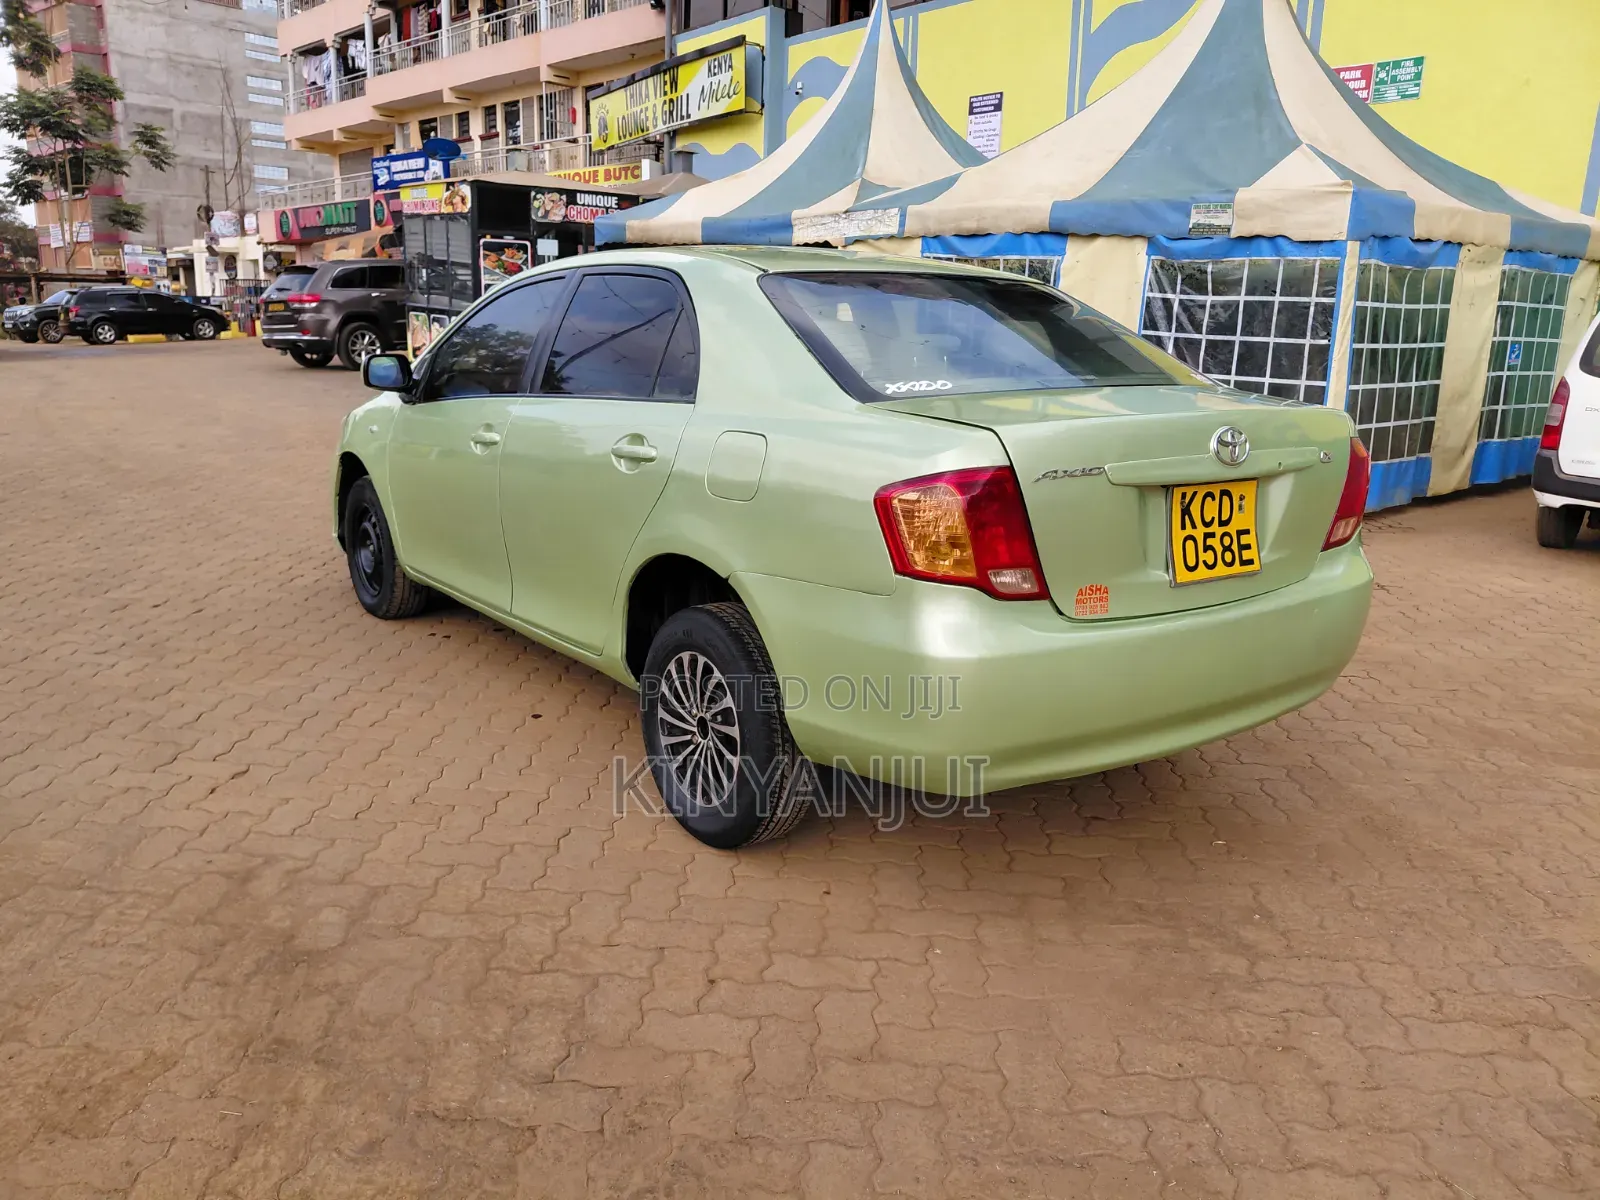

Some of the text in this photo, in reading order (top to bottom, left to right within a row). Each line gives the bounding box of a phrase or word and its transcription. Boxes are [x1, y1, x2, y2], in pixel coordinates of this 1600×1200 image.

[707, 53, 733, 79] KENYA
[1391, 65, 1422, 75] ASSEMBLY
[1340, 70, 1362, 80] PARK
[1397, 73, 1415, 82] POINT
[624, 81, 650, 111] THIKA
[652, 65, 680, 100] VIEW
[697, 75, 743, 111] Milele
[616, 108, 650, 141] LOUNGE
[651, 103, 659, 129] &
[661, 92, 692, 125] GRILL
[576, 192, 619, 208] UNIQUE
[1031, 466, 1106, 483] AXIO
[1180, 488, 1234, 531] KCD
[1181, 528, 1255, 573] 058E
[1075, 583, 1109, 597] AISHA
[1075, 595, 1109, 606] MOTORS
